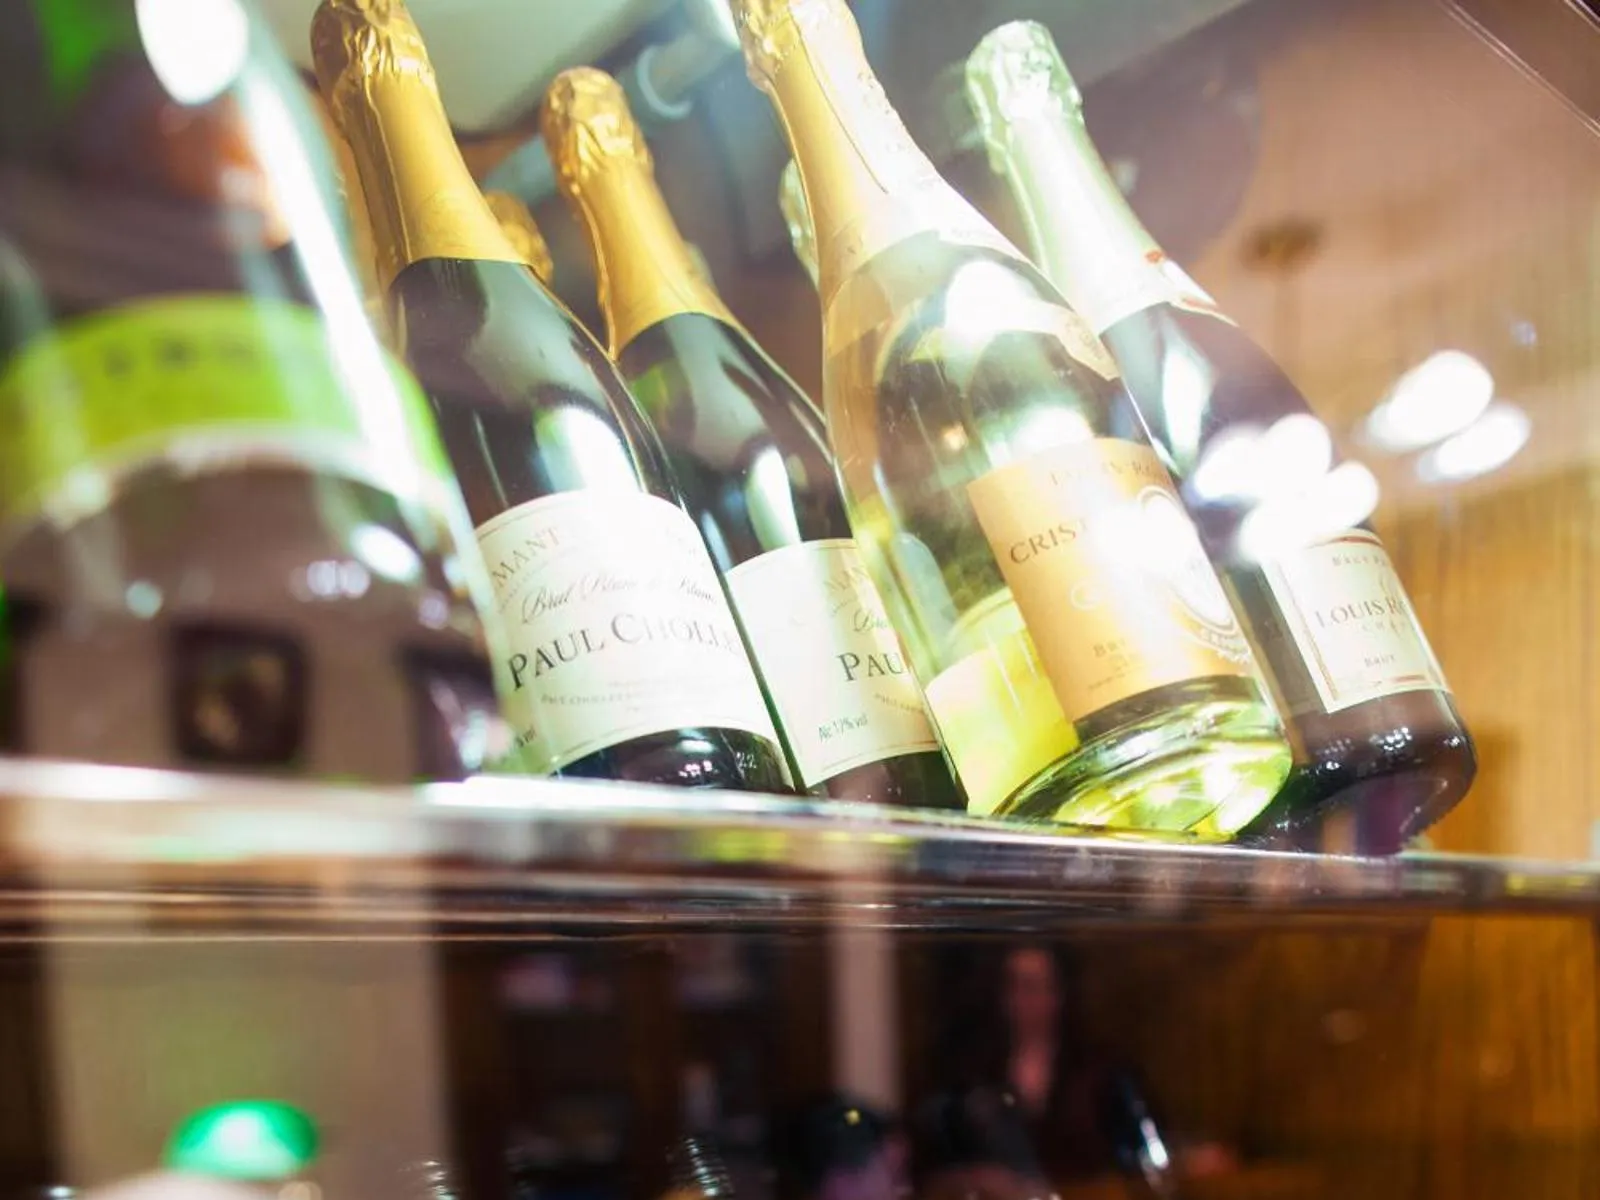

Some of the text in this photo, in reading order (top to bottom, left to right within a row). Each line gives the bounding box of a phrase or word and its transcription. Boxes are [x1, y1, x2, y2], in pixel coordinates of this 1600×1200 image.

[1315, 599, 1385, 629] LOUIS
[507, 628, 605, 691] PAUL
[835, 651, 904, 682] PAU
